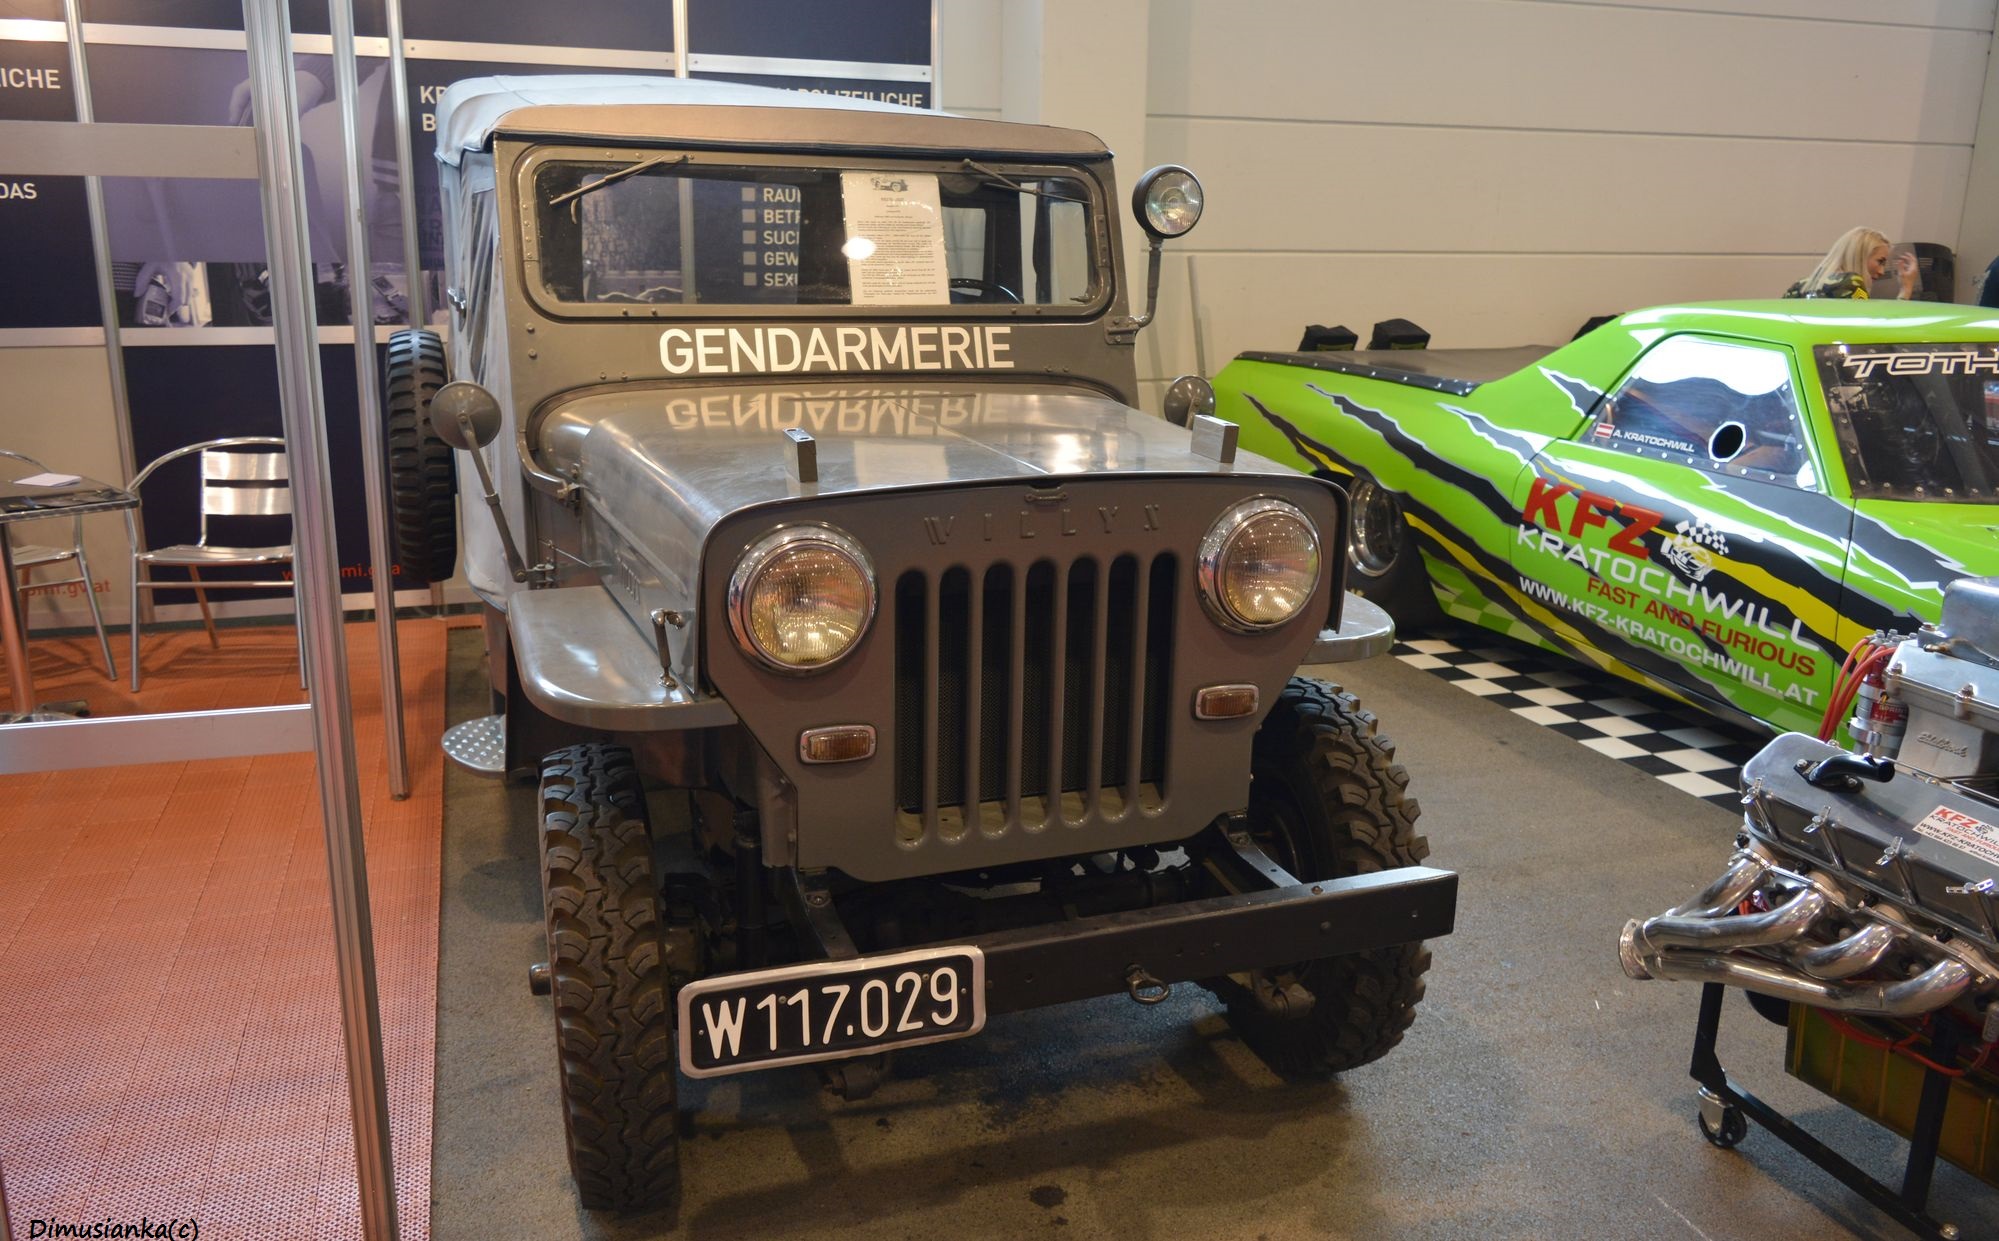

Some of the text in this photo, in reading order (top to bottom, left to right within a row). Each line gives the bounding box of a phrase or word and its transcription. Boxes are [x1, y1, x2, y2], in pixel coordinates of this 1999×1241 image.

[0, 67, 61, 89] ICHE
[659, 325, 1015, 375] GENDARMERIE
[1613, 429, 1695, 453] A. KRATOCHWILL
[924, 503, 1160, 546] WILLYS
[1522, 477, 1664, 561] KFZ
[1517, 523, 1820, 652] KRATOCHWILL
[1519, 575, 1819, 707] WWW.KFZ-KRATOCHWILL.AT
[1587, 576, 1816, 678] FAST AND FURIOUS
[1936, 808, 1979, 829] KFZ
[702, 967, 959, 1060] W 117.029
